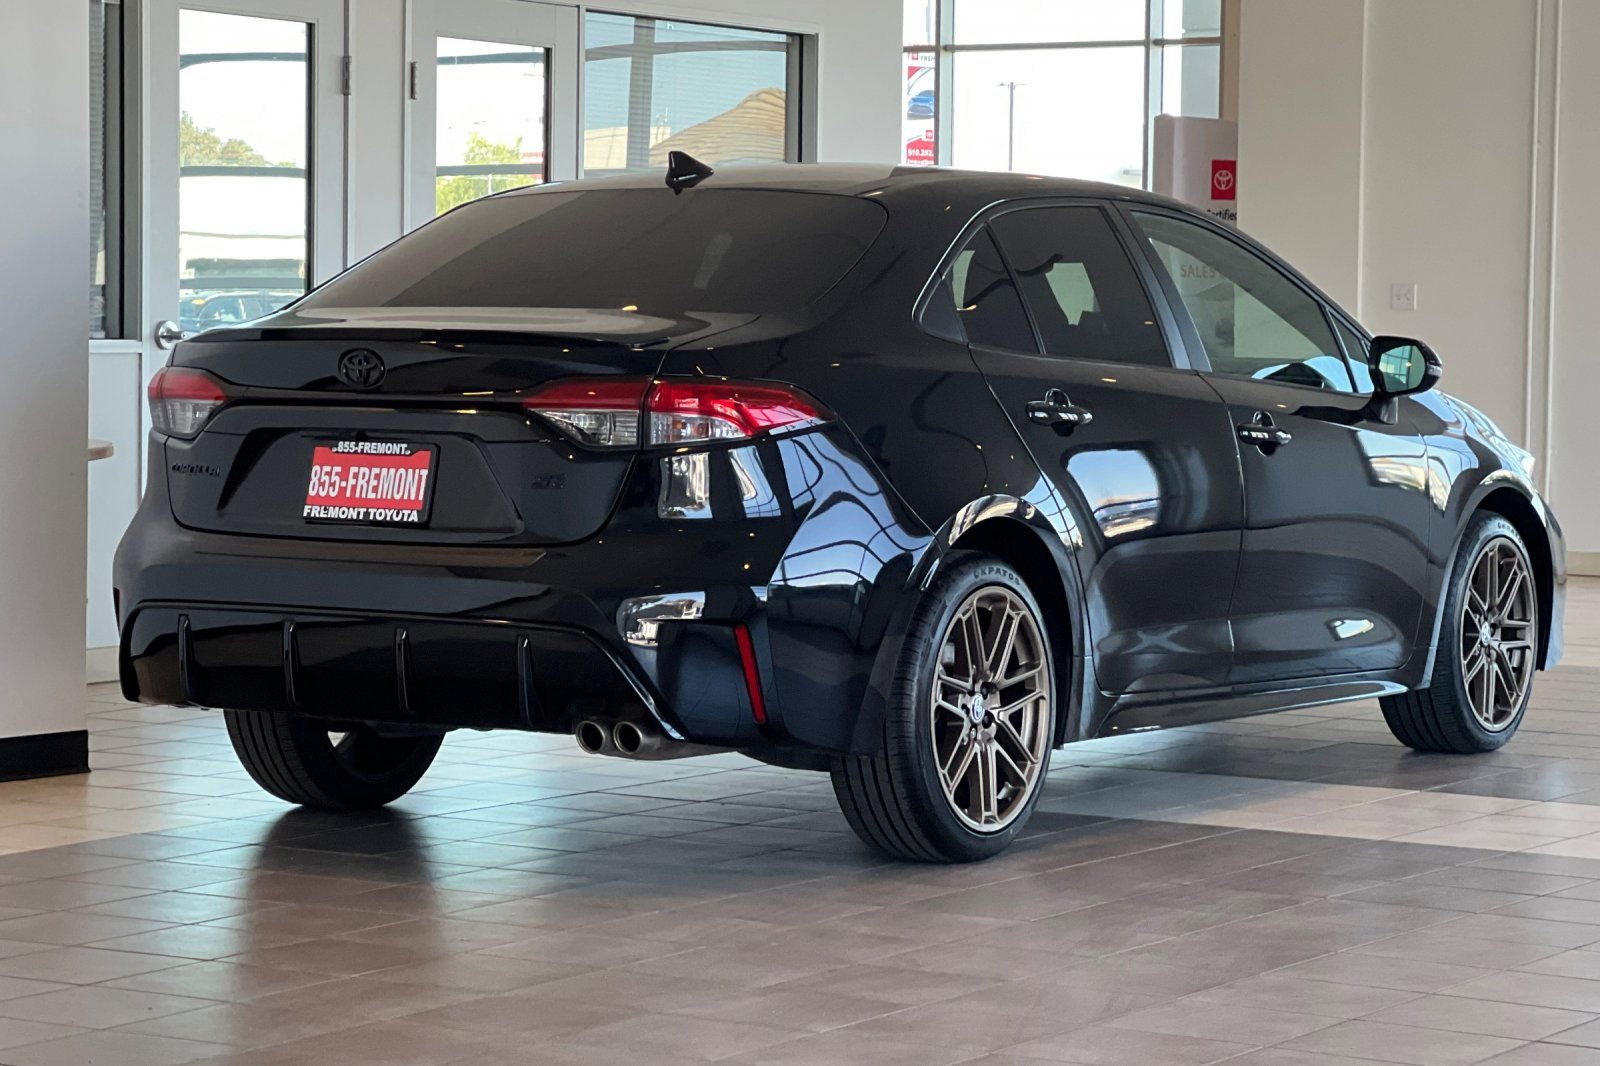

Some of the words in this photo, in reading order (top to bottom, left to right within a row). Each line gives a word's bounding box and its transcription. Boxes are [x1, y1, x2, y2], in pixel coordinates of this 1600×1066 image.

[1206, 208, 1237, 221] rtifie
[1180, 264, 1215, 279] SALES
[337, 441, 408, 455] 855-FREMONT
[308, 464, 429, 501] 855-FREMONT
[302, 504, 367, 520] FREMONT
[368, 507, 419, 522] TOYOTA
